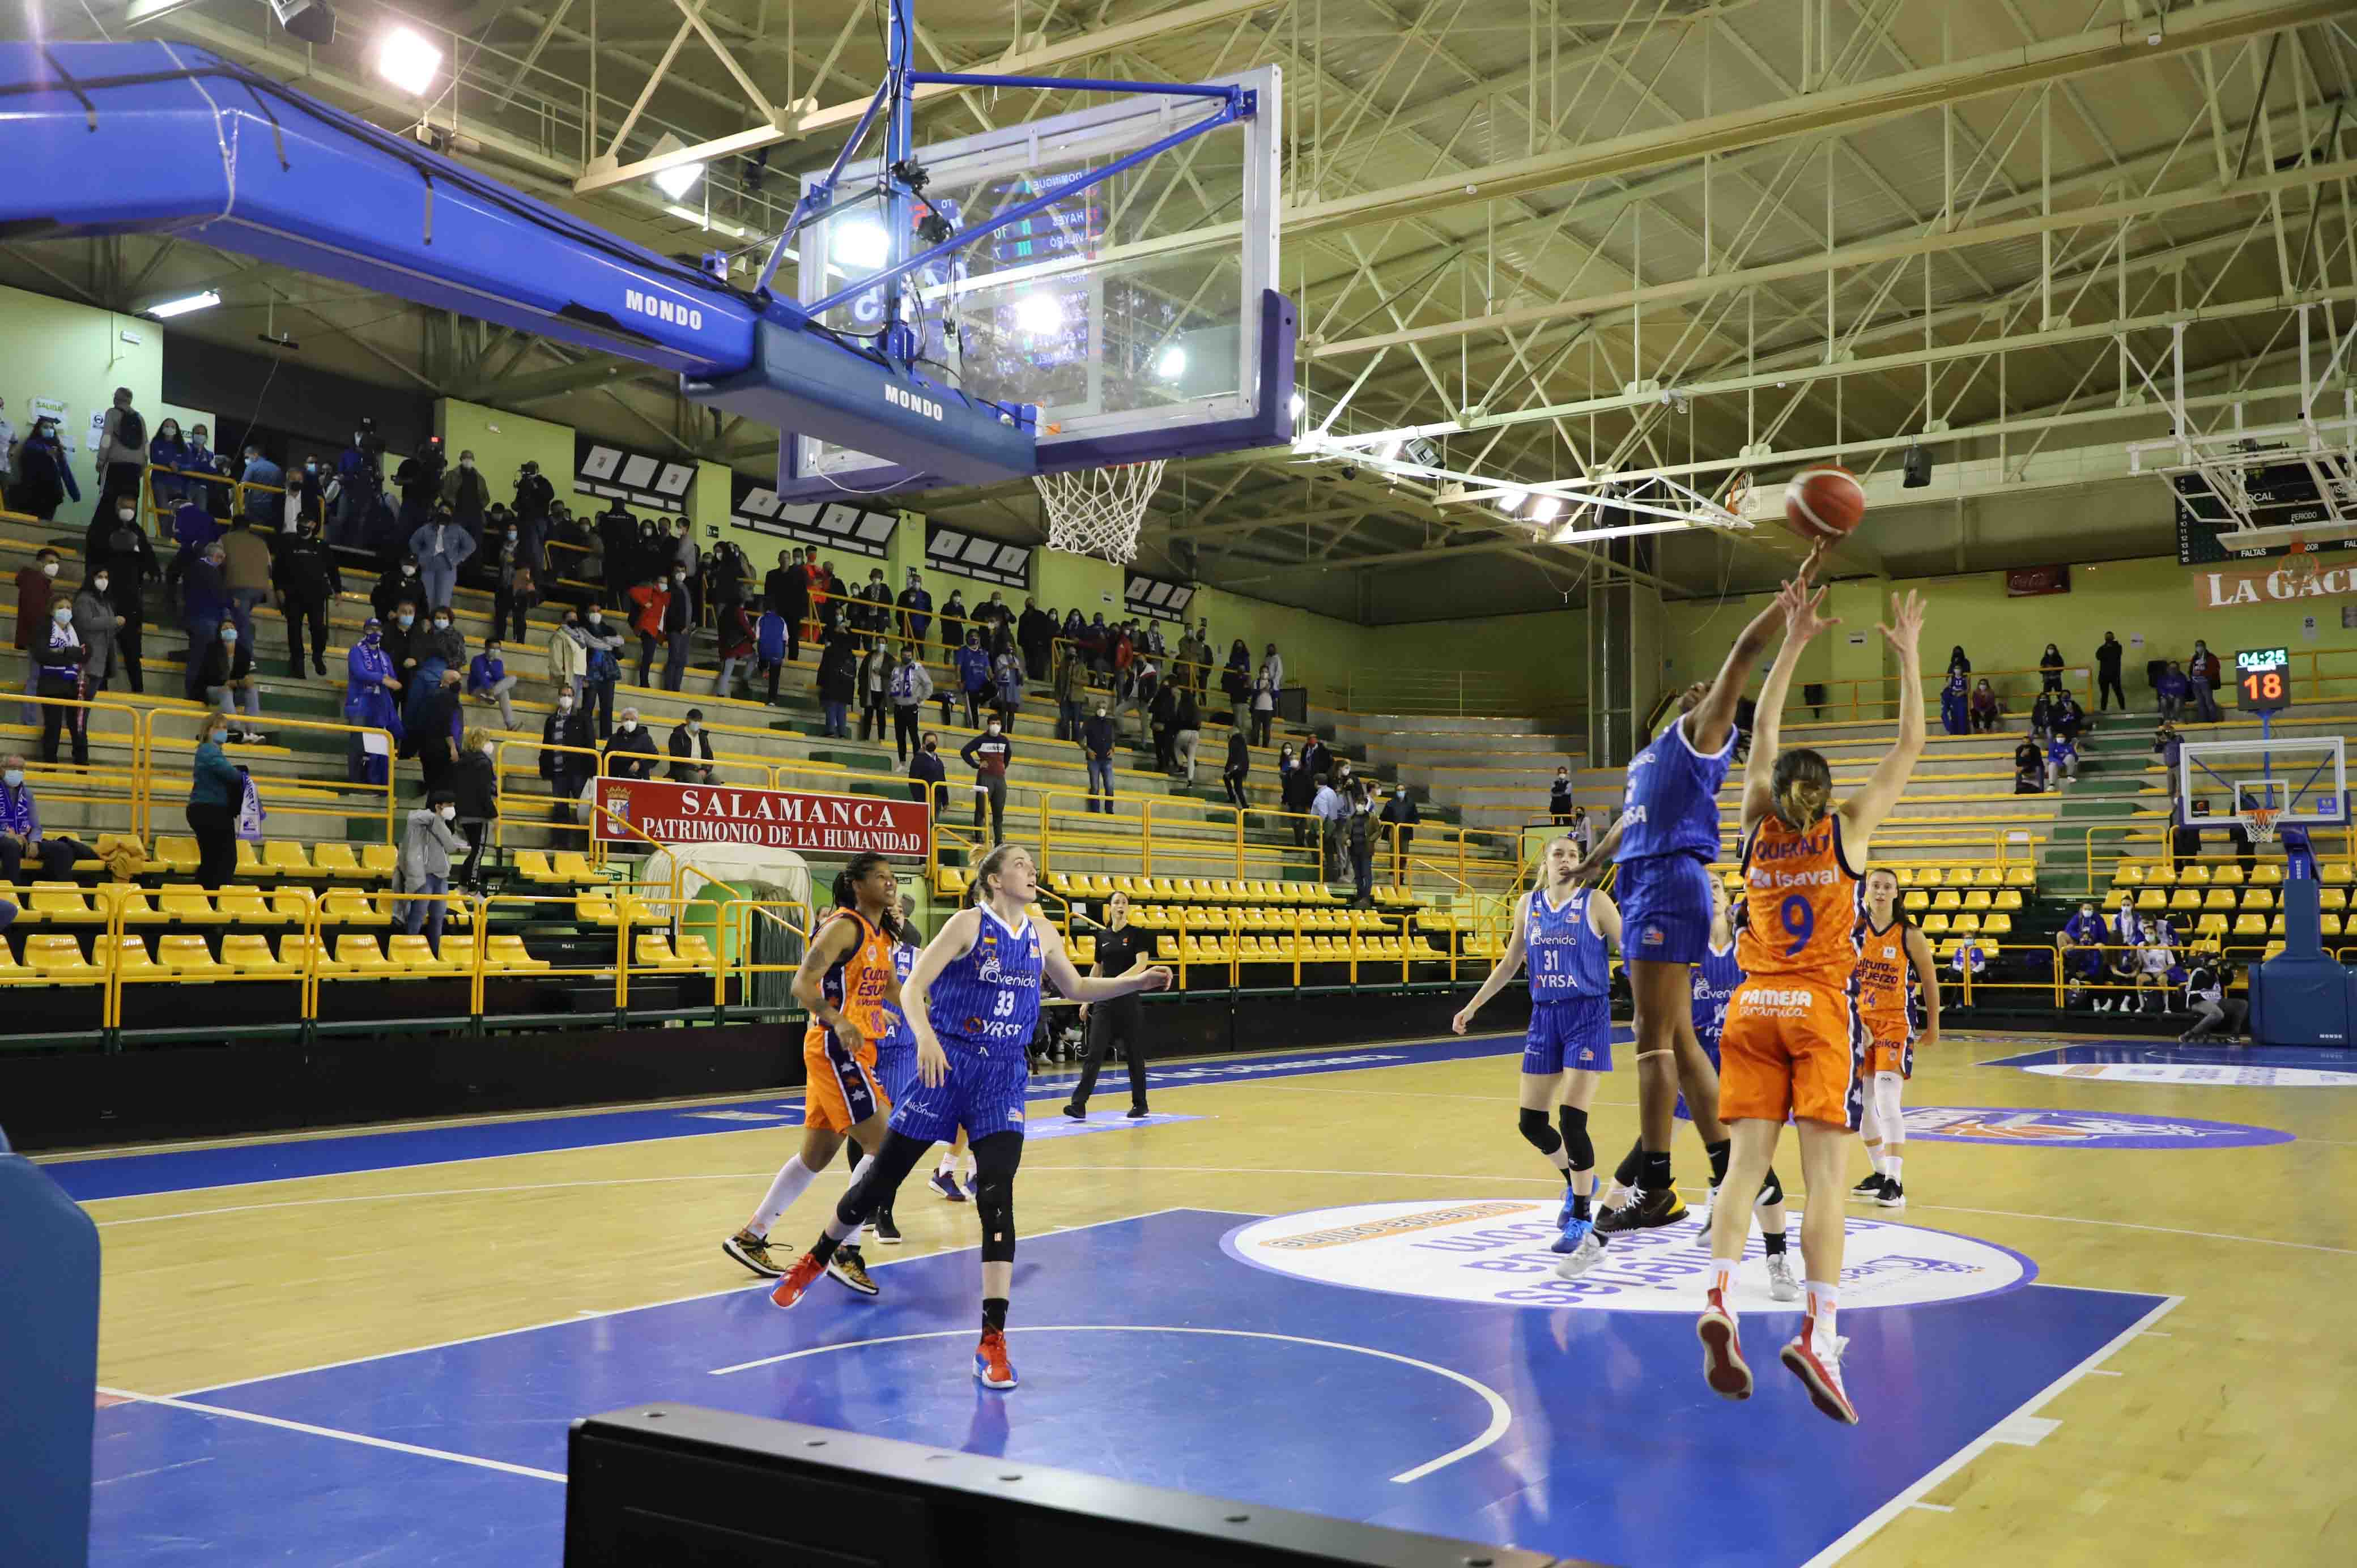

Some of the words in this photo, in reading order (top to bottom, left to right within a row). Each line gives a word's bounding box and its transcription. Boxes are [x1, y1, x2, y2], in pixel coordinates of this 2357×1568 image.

[626, 289, 703, 331] MONDO
[885, 384, 943, 422] MONDO
[2241, 548, 2266, 557] FALTAS
[2207, 573, 2261, 607] LA
[2238, 649, 2286, 667] 04:25
[2243, 673, 2282, 701] 18
[680, 790, 896, 828] SALAMANCA
[642, 816, 762, 845] PATRIMONIO
[768, 826, 792, 845] DE
[797, 829, 819, 847] LA
[824, 830, 920, 851] HUMANIDAD
[1756, 833, 1830, 861] QUERALT
[1775, 865, 1840, 888] isaval
[1781, 893, 1814, 957] 9
[1543, 949, 1559, 971] 31
[993, 990, 1015, 1016] 33
[1739, 989, 1812, 1007] PAMESA
